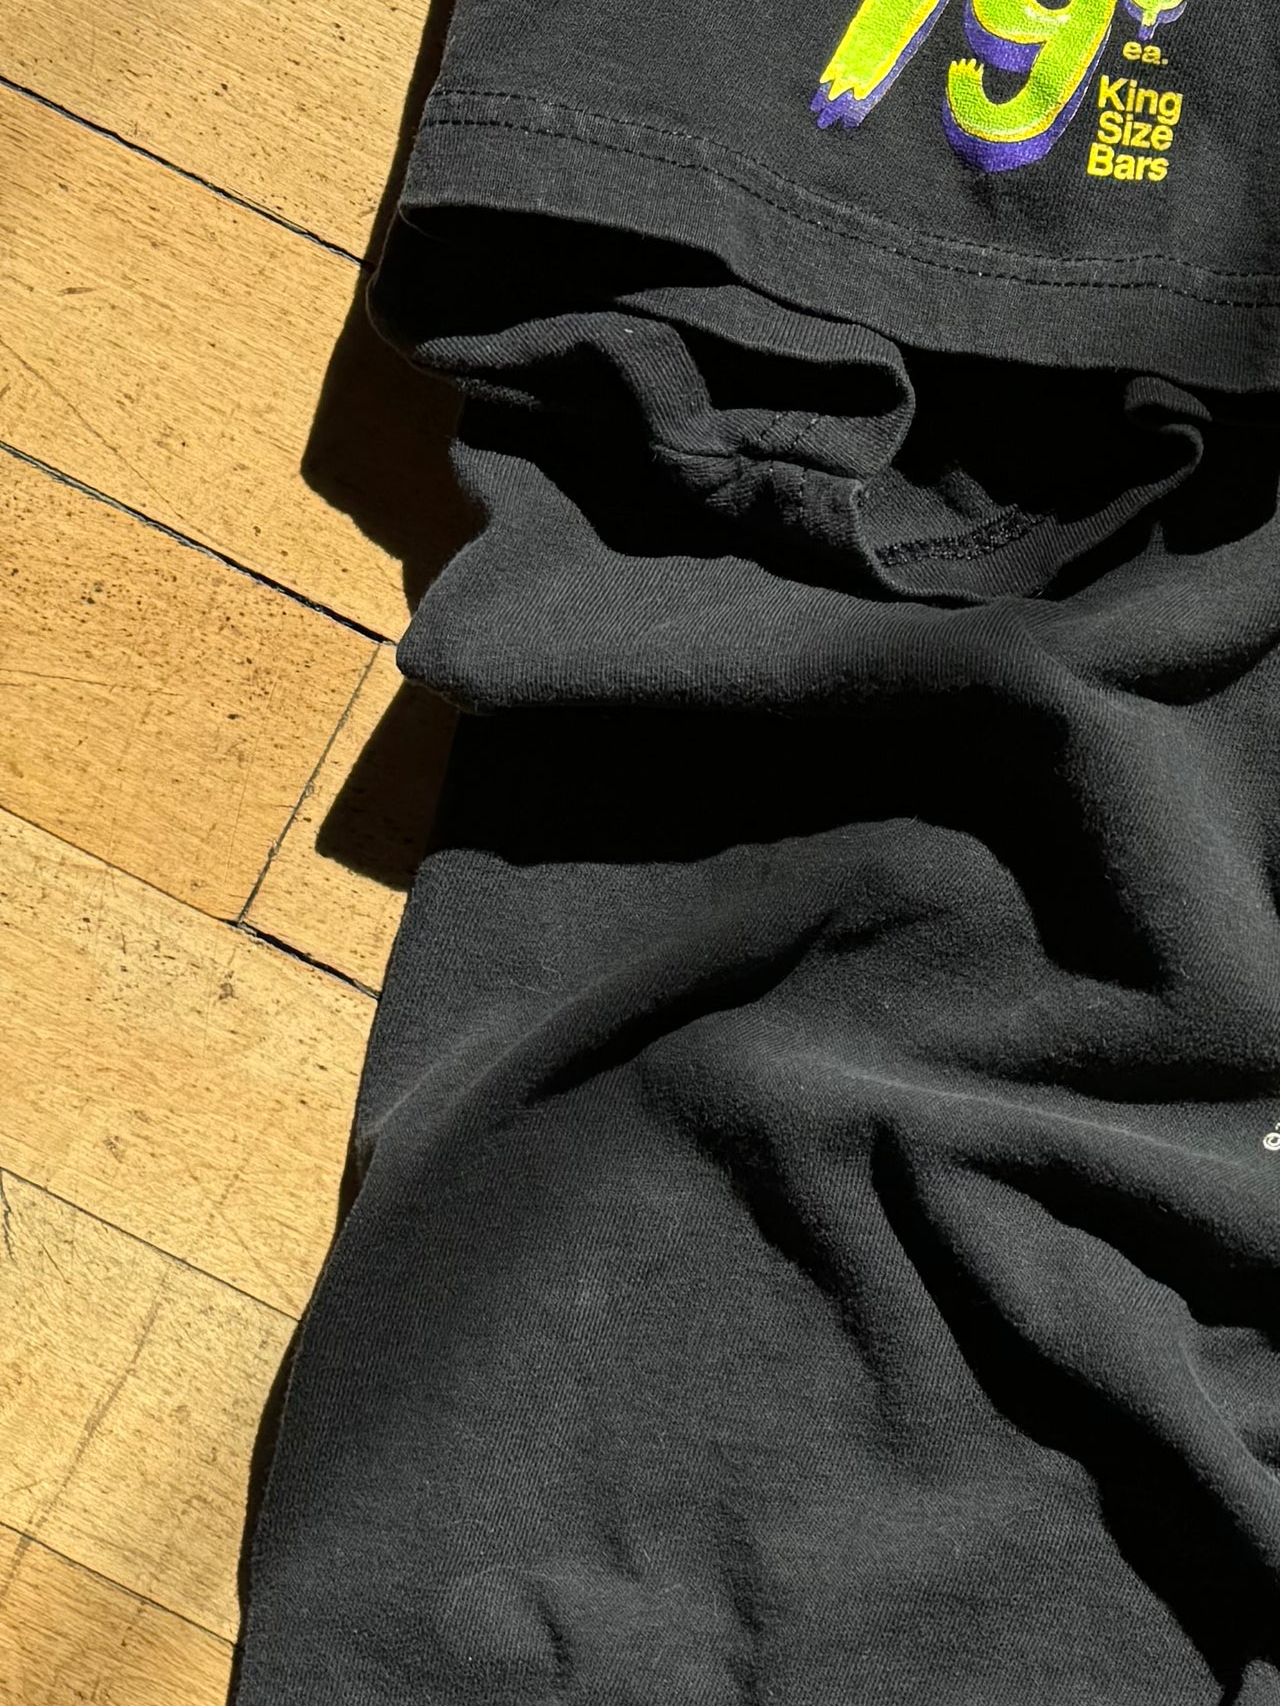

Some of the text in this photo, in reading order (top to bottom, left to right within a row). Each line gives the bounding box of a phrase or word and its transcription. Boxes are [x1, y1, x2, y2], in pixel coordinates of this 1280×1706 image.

[1122, 42, 1169, 65] ea.
[1098, 75, 1183, 125] King
[1096, 110, 1174, 151] Size
[1087, 142, 1171, 181] Bars
